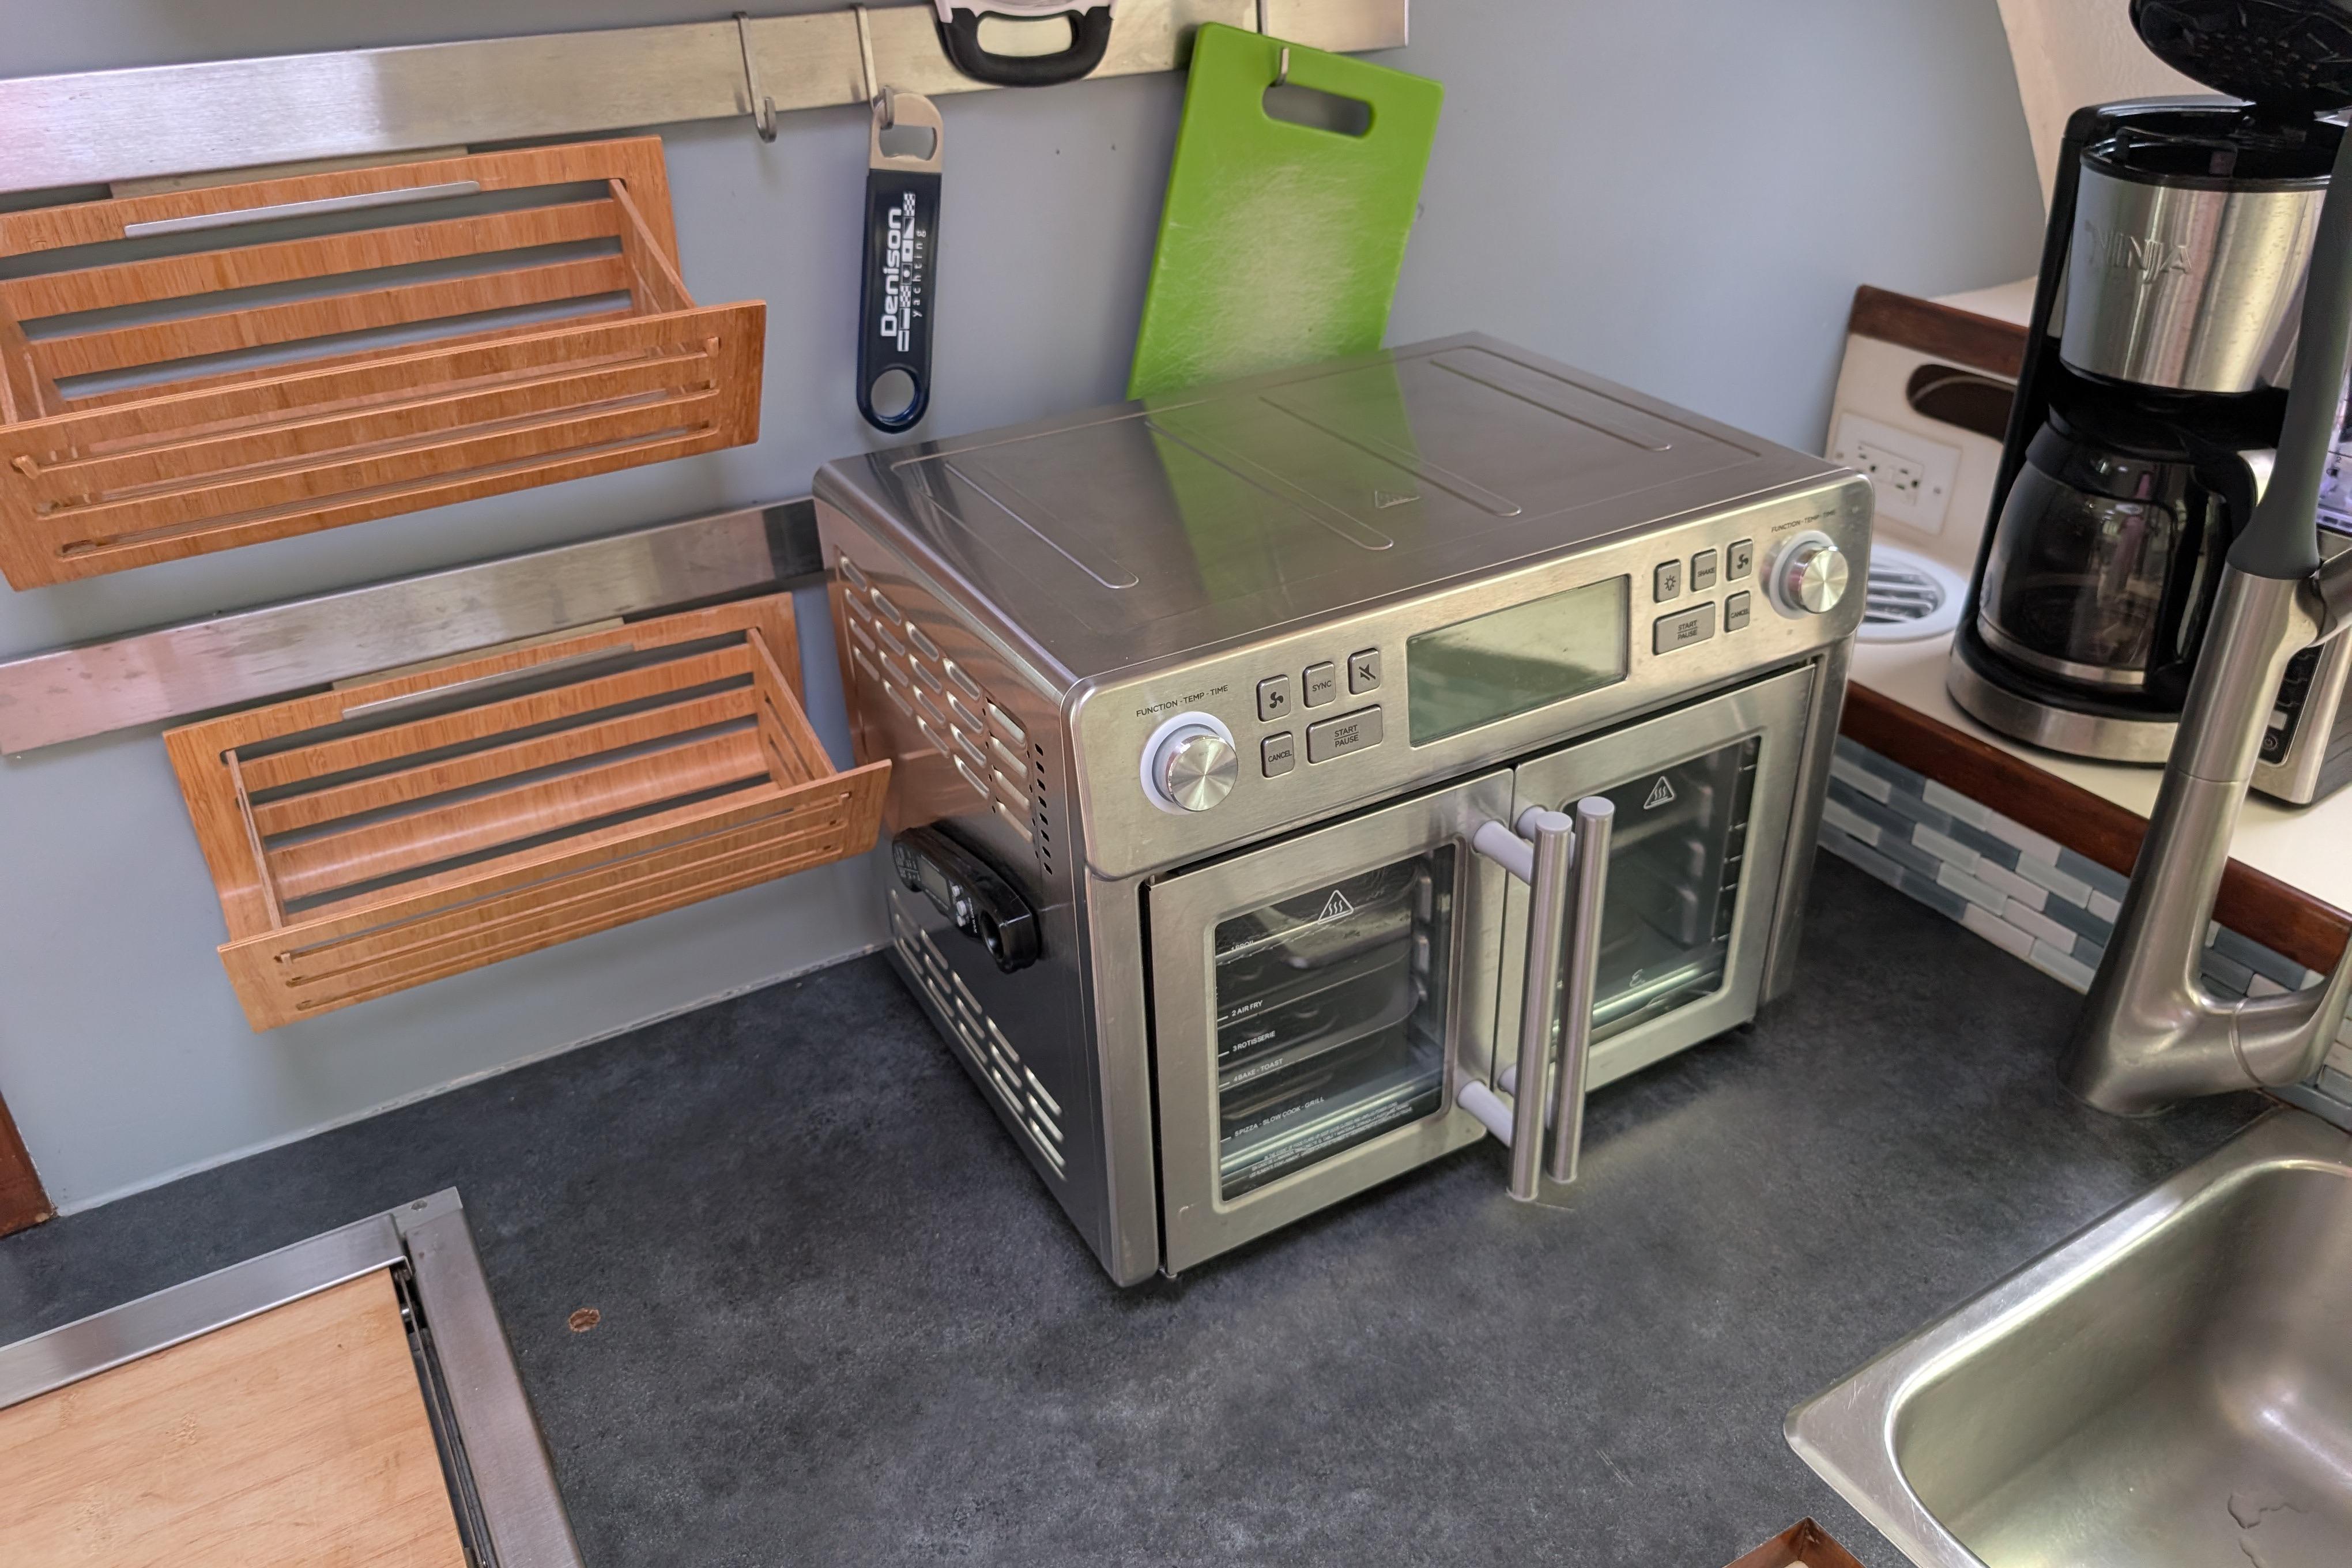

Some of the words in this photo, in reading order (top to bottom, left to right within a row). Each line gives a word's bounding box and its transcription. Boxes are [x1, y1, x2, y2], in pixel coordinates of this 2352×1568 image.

[2086, 223, 2192, 285] NINJA
[880, 207, 902, 337] Denison
[913, 229, 926, 318] yachting
[1771, 520, 1801, 533] FUNCTION
[1678, 620, 1698, 631] START
[1678, 629, 1698, 640] PAUSE
[1312, 680, 1332, 692] SYNC
[1136, 699, 1178, 717] FUNCTION
[1183, 692, 1205, 704] TEMP
[1210, 684, 1228, 696] TIME
[1335, 724, 1358, 738] START
[1335, 734, 1359, 748] PAUSE
[1268, 750, 1292, 763] CANCEL
[1237, 1005, 1249, 1015] AIR
[1250, 1000, 1263, 1010] FRY
[1238, 1069, 1256, 1081] BAKE
[1260, 1058, 1284, 1071] TOAST
[1239, 1123, 1259, 1135] PIZZA
[1262, 1113, 1282, 1125] SLOW
[1282, 1106, 1301, 1118] COOK
[1304, 1096, 1325, 1109] GRILL
